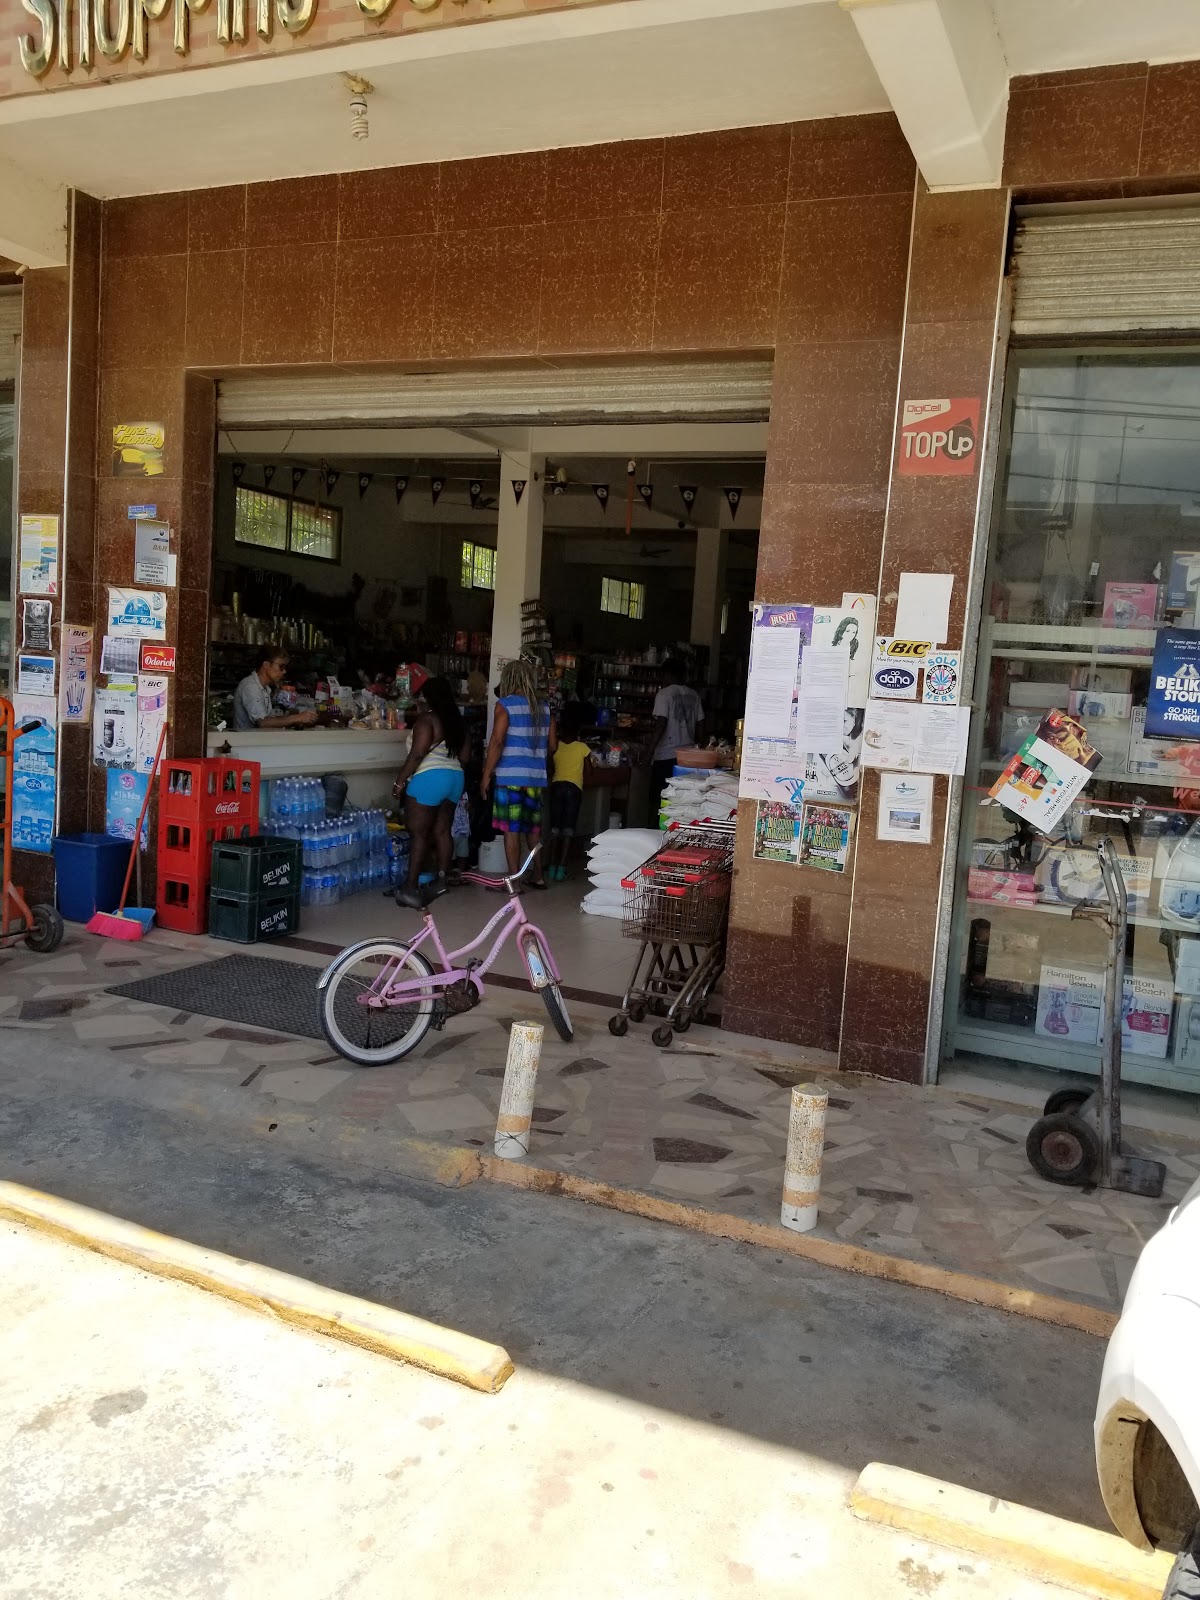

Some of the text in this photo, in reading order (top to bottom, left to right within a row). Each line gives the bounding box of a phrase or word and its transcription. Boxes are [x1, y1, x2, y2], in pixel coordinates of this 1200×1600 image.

[145, 656, 174, 667] Oderich
[928, 657, 957, 667] SOLD
[880, 674, 910, 684] dana
[925, 692, 955, 702] HERE
[1163, 712, 1200, 723] STRONG!
[215, 802, 240, 814] Coca-Cola
[263, 863, 290, 884] BELIKIN
[260, 908, 288, 930] BELIKIN
[1047, 970, 1086, 982] Hamilton
[1068, 979, 1097, 989] Beach
[1123, 978, 1155, 988] milton
[1135, 986, 1166, 997] Beach
[1144, 1003, 1168, 1012] Blender
